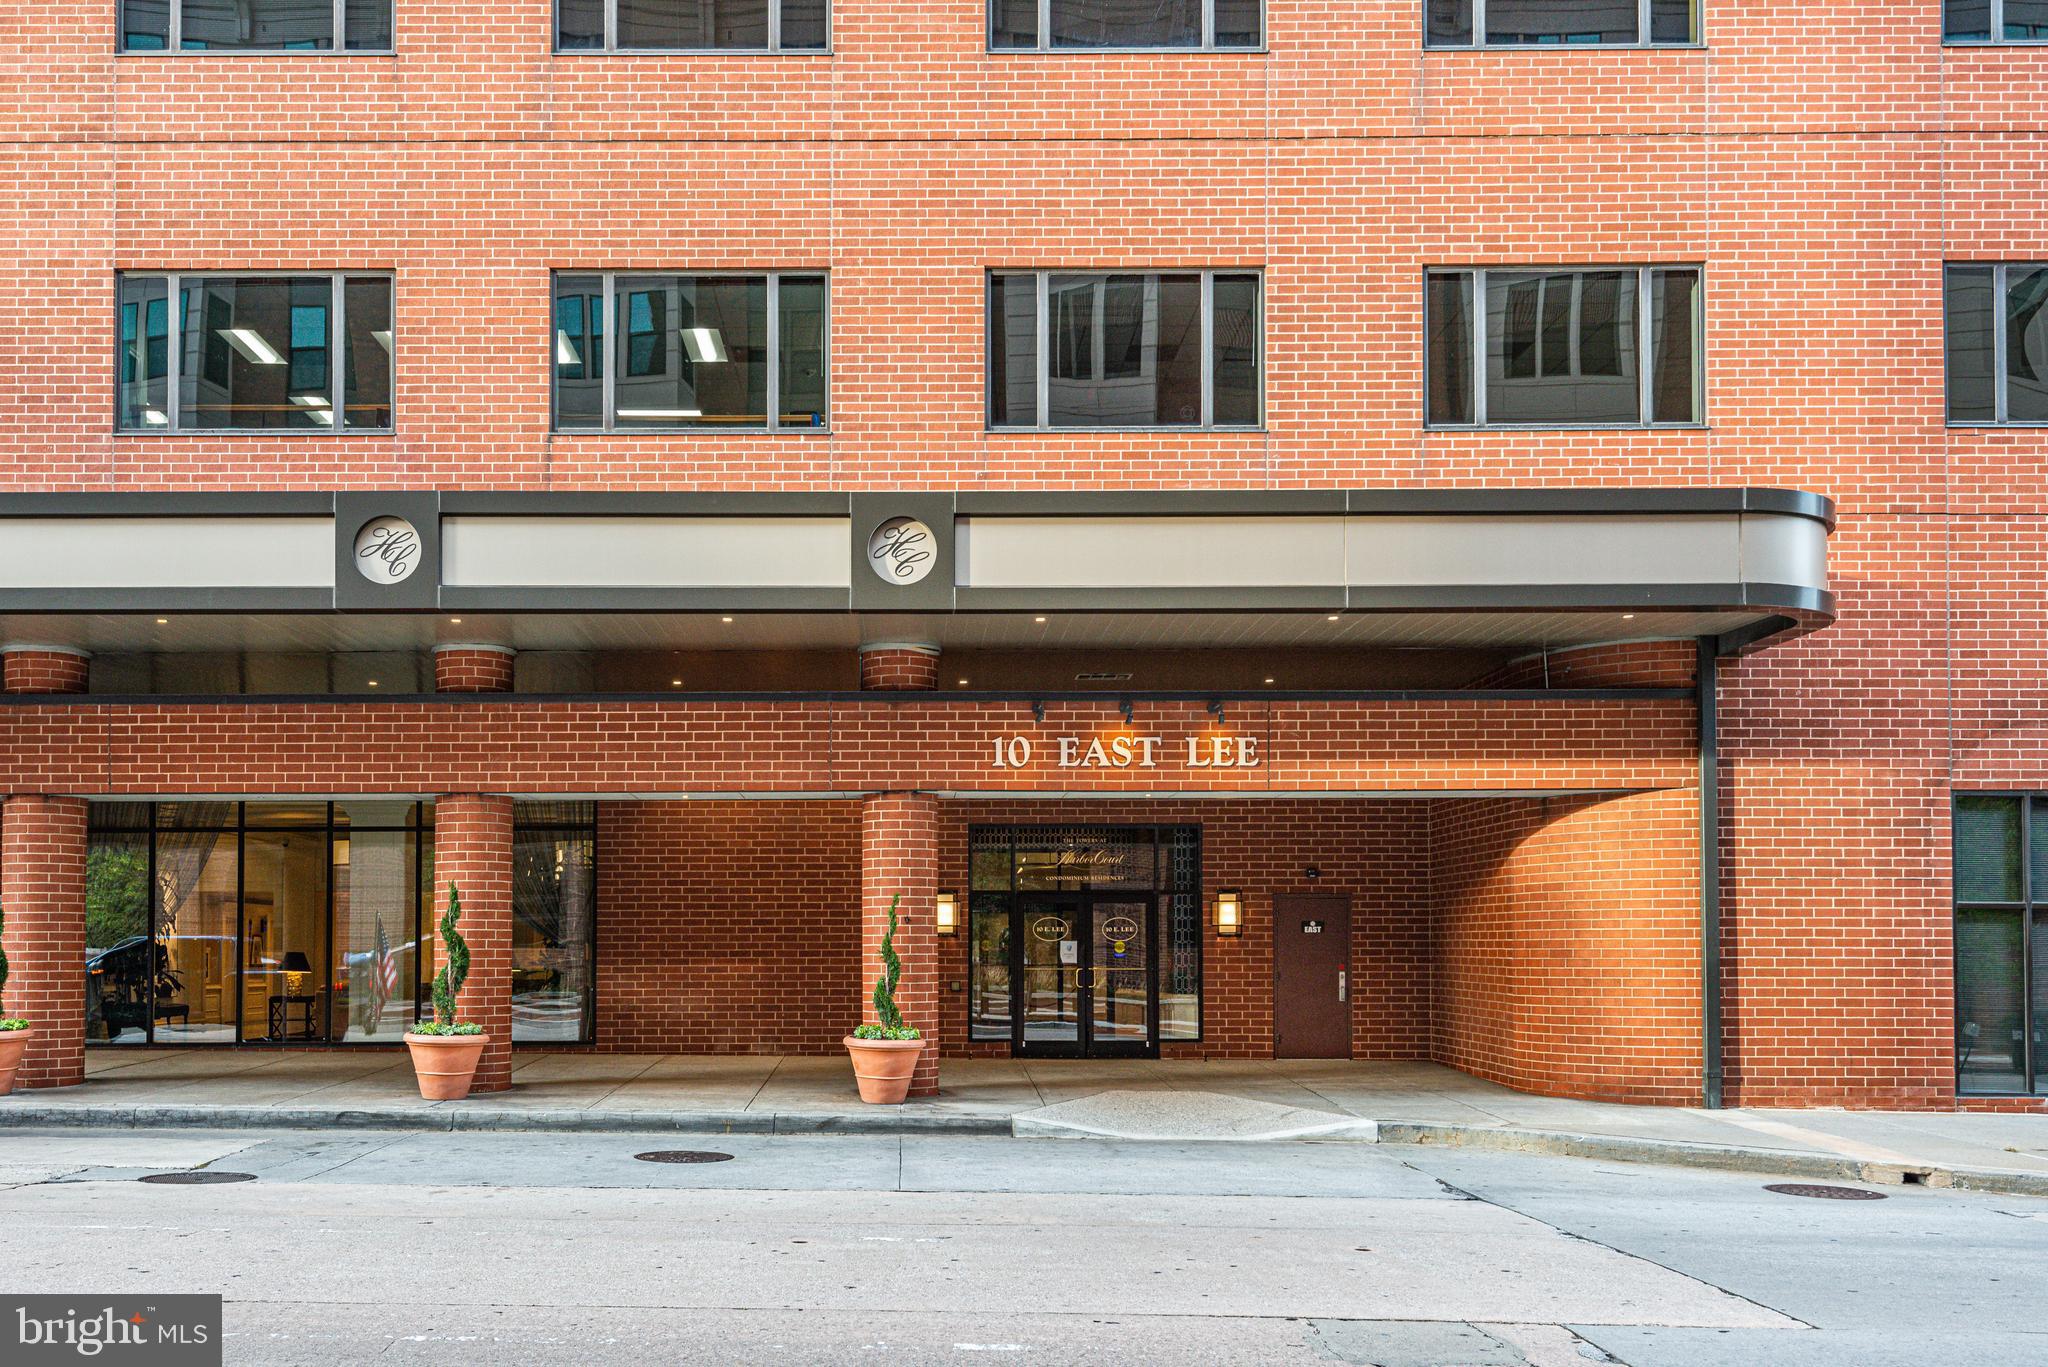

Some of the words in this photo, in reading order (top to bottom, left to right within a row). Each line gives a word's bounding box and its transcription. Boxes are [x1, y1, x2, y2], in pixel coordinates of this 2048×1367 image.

[991, 736, 1031, 768] 10
[1057, 736, 1162, 767] EAST
[1185, 736, 1259, 767] LEE
